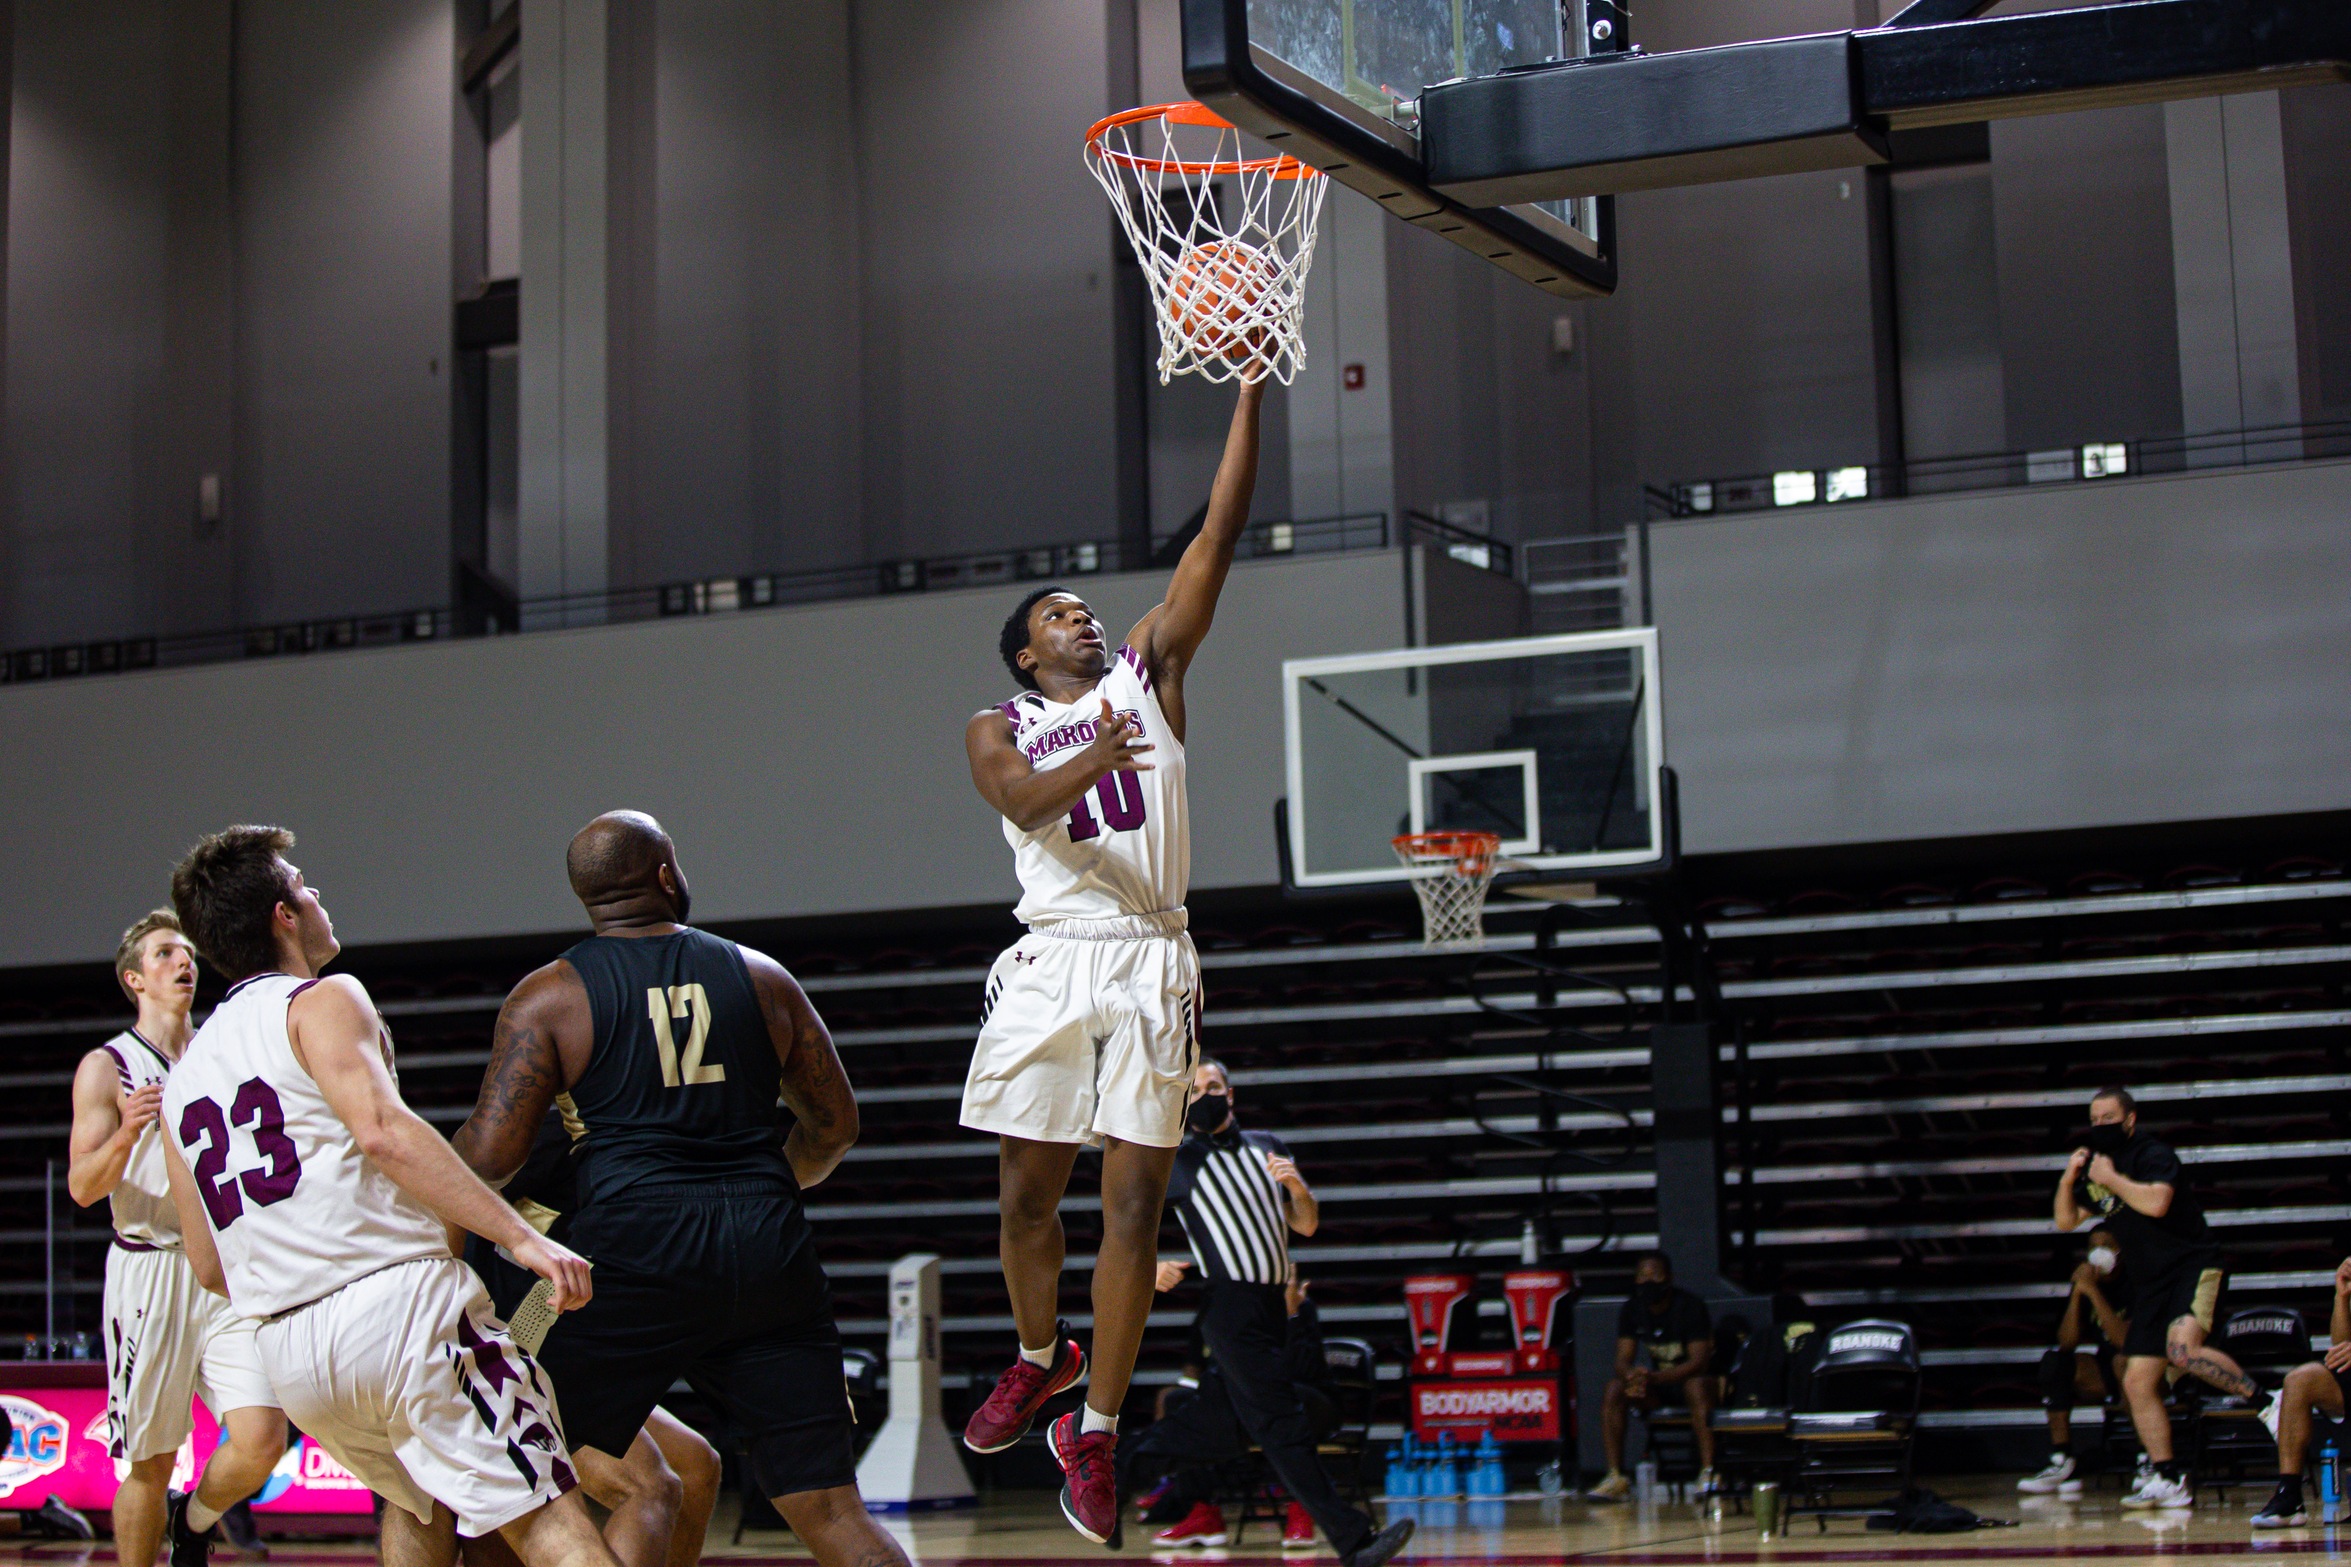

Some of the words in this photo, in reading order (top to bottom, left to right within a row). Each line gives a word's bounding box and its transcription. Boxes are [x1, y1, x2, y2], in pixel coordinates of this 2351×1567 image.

[1025, 709, 1146, 766] MAROS
[647, 983, 726, 1088] 12
[179, 1076, 302, 1232] 23
[1829, 1333, 1904, 1354] ROANOKE
[2227, 1317, 2295, 1338] ROANOKE
[1420, 1389, 1550, 1415] BODYARMOR
